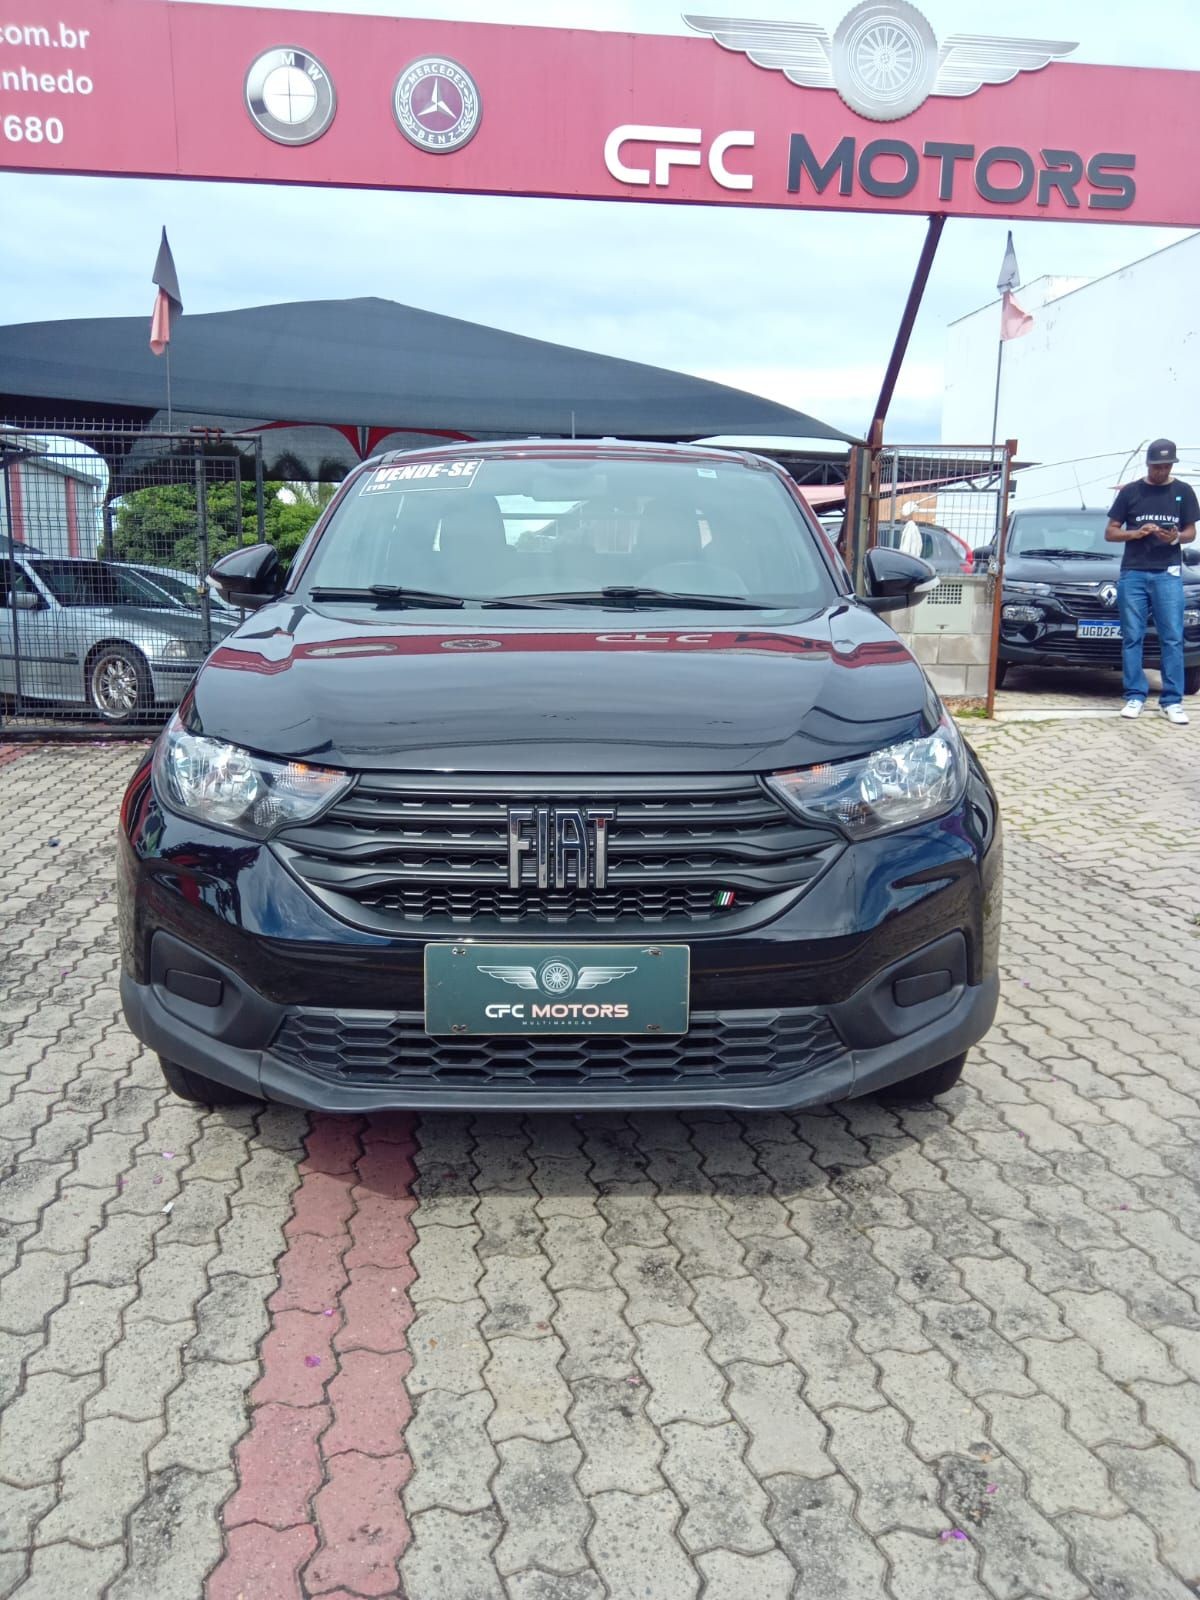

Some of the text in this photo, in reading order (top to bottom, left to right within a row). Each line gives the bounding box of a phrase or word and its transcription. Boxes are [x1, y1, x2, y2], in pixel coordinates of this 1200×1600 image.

[0, 66, 94, 95] nhedo
[260, 52, 323, 81] MW
[408, 63, 467, 89] MERCEDES
[0, 115, 64, 144] 680
[417, 131, 457, 144] BENZ
[604, 124, 1136, 210] CFC MOTORS
[375, 461, 478, 483] VENDE-SE
[508, 808, 617, 889] FIAT
[485, 1004, 630, 1018] CFC MOTORS
